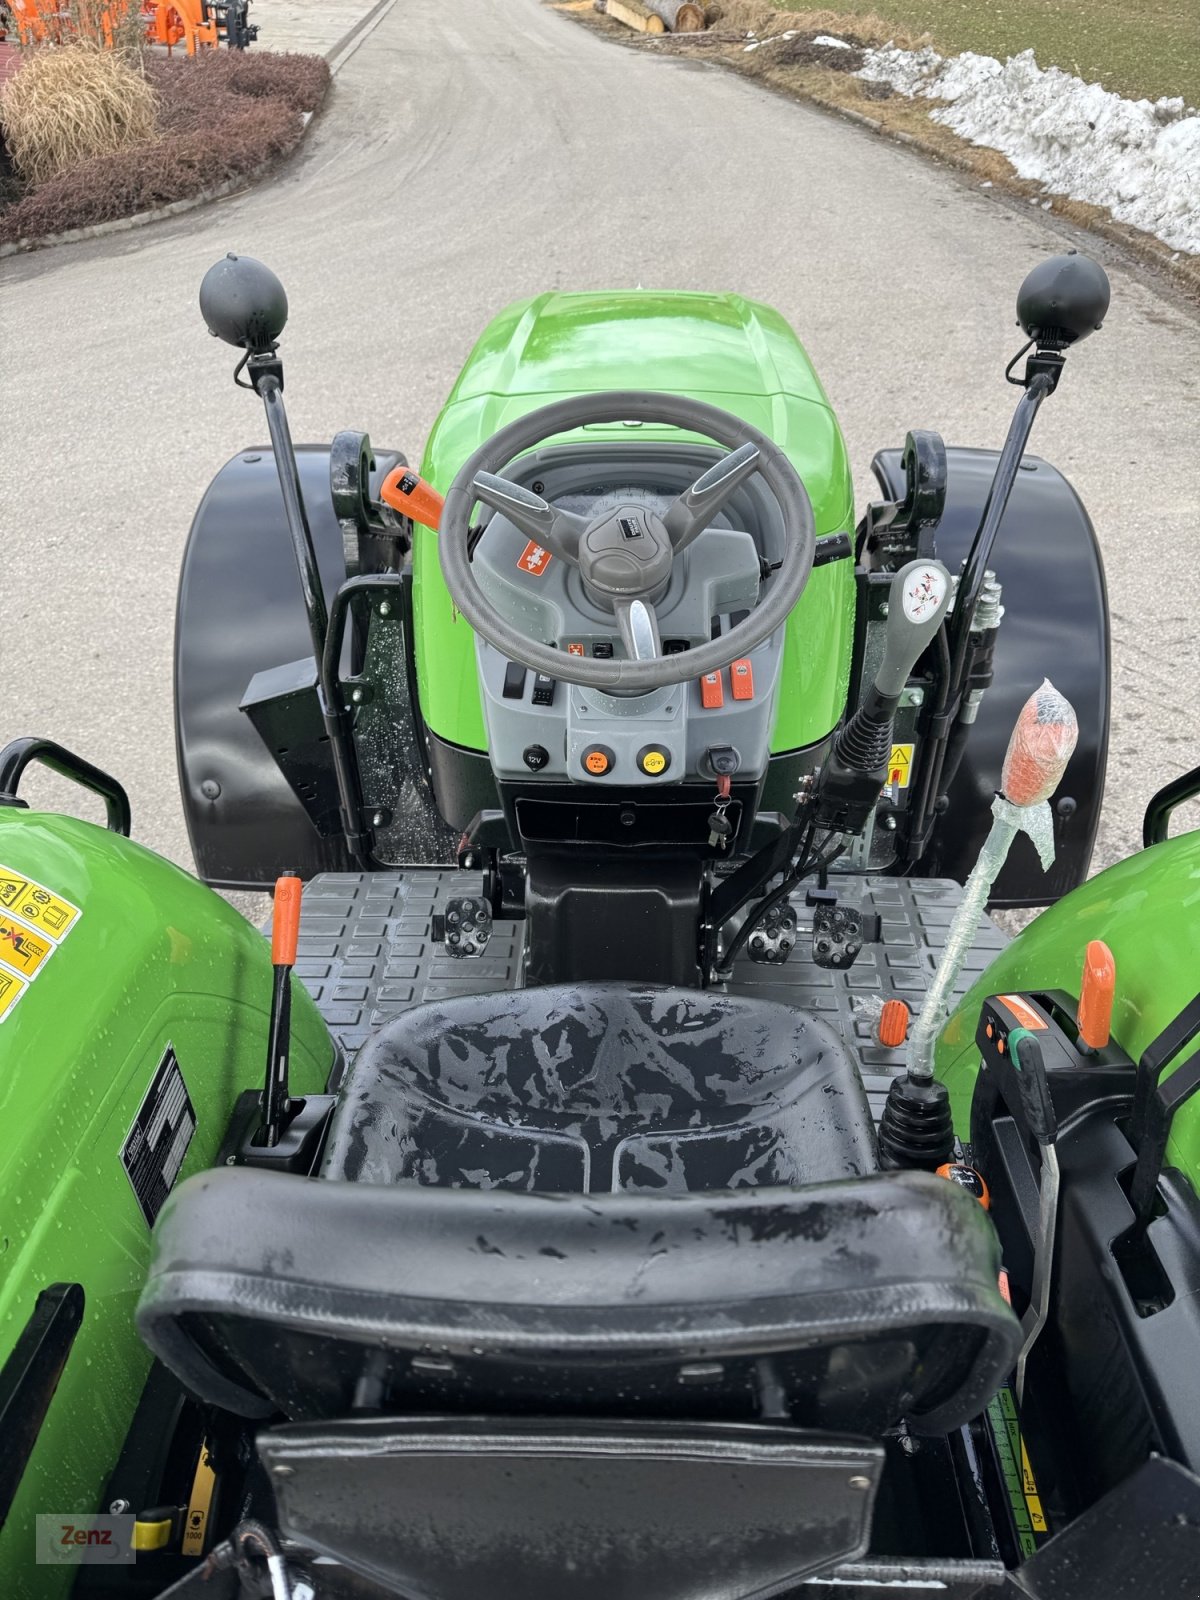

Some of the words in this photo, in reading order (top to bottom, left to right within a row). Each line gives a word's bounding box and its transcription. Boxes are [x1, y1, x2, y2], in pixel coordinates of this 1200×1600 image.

[528, 755, 541, 764] 12V
[24, 906, 35, 916] P
[186, 1532, 202, 1540] 1000
